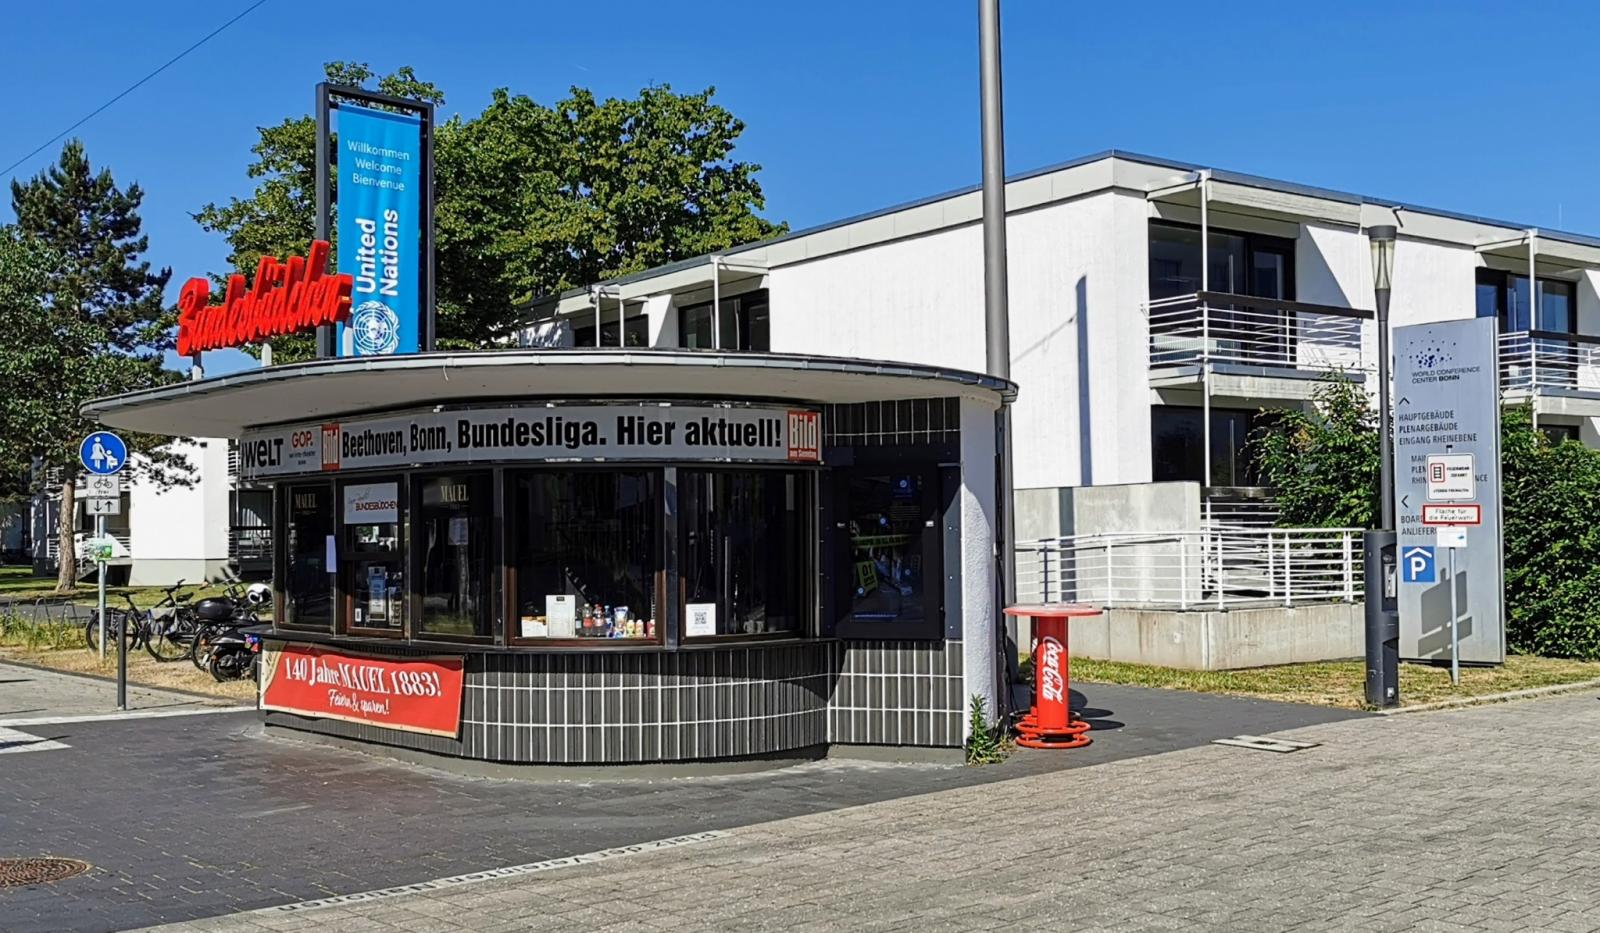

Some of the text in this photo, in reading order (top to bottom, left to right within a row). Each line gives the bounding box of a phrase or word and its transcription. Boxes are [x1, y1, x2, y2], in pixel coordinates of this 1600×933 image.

[347, 139, 410, 161] Willkommen
[355, 157, 402, 175] Welcome
[352, 174, 405, 191] Bienvenue
[355, 218, 376, 293] United
[378, 208, 398, 296] Nations
[1412, 366, 1480, 378] WORLD CONFERENCE
[1399, 410, 1455, 422] HAUPTGEBÄUDE
[342, 416, 781, 457] Beethoven, Bonn, Bundesliga. Hier aktuell!
[789, 413, 817, 449] Bild
[1399, 422, 1459, 434] PLENARGEBÄUDE
[291, 431, 313, 448] GOP.
[322, 429, 338, 464] Bild
[1399, 433, 1478, 446] EINGANG RHEINEBENE
[440, 484, 470, 502] MAUEL
[1411, 557, 1426, 581] P
[285, 657, 307, 681] 140
[309, 657, 340, 687] Jahre
[338, 662, 390, 694] MAUEL
[390, 670, 442, 697] 1883!
[328, 688, 390, 718] Feiern & sparen!
[656, 832, 718, 848] Platz
[599, 846, 643, 859] der
[277, 883, 437, 911] Nationen
